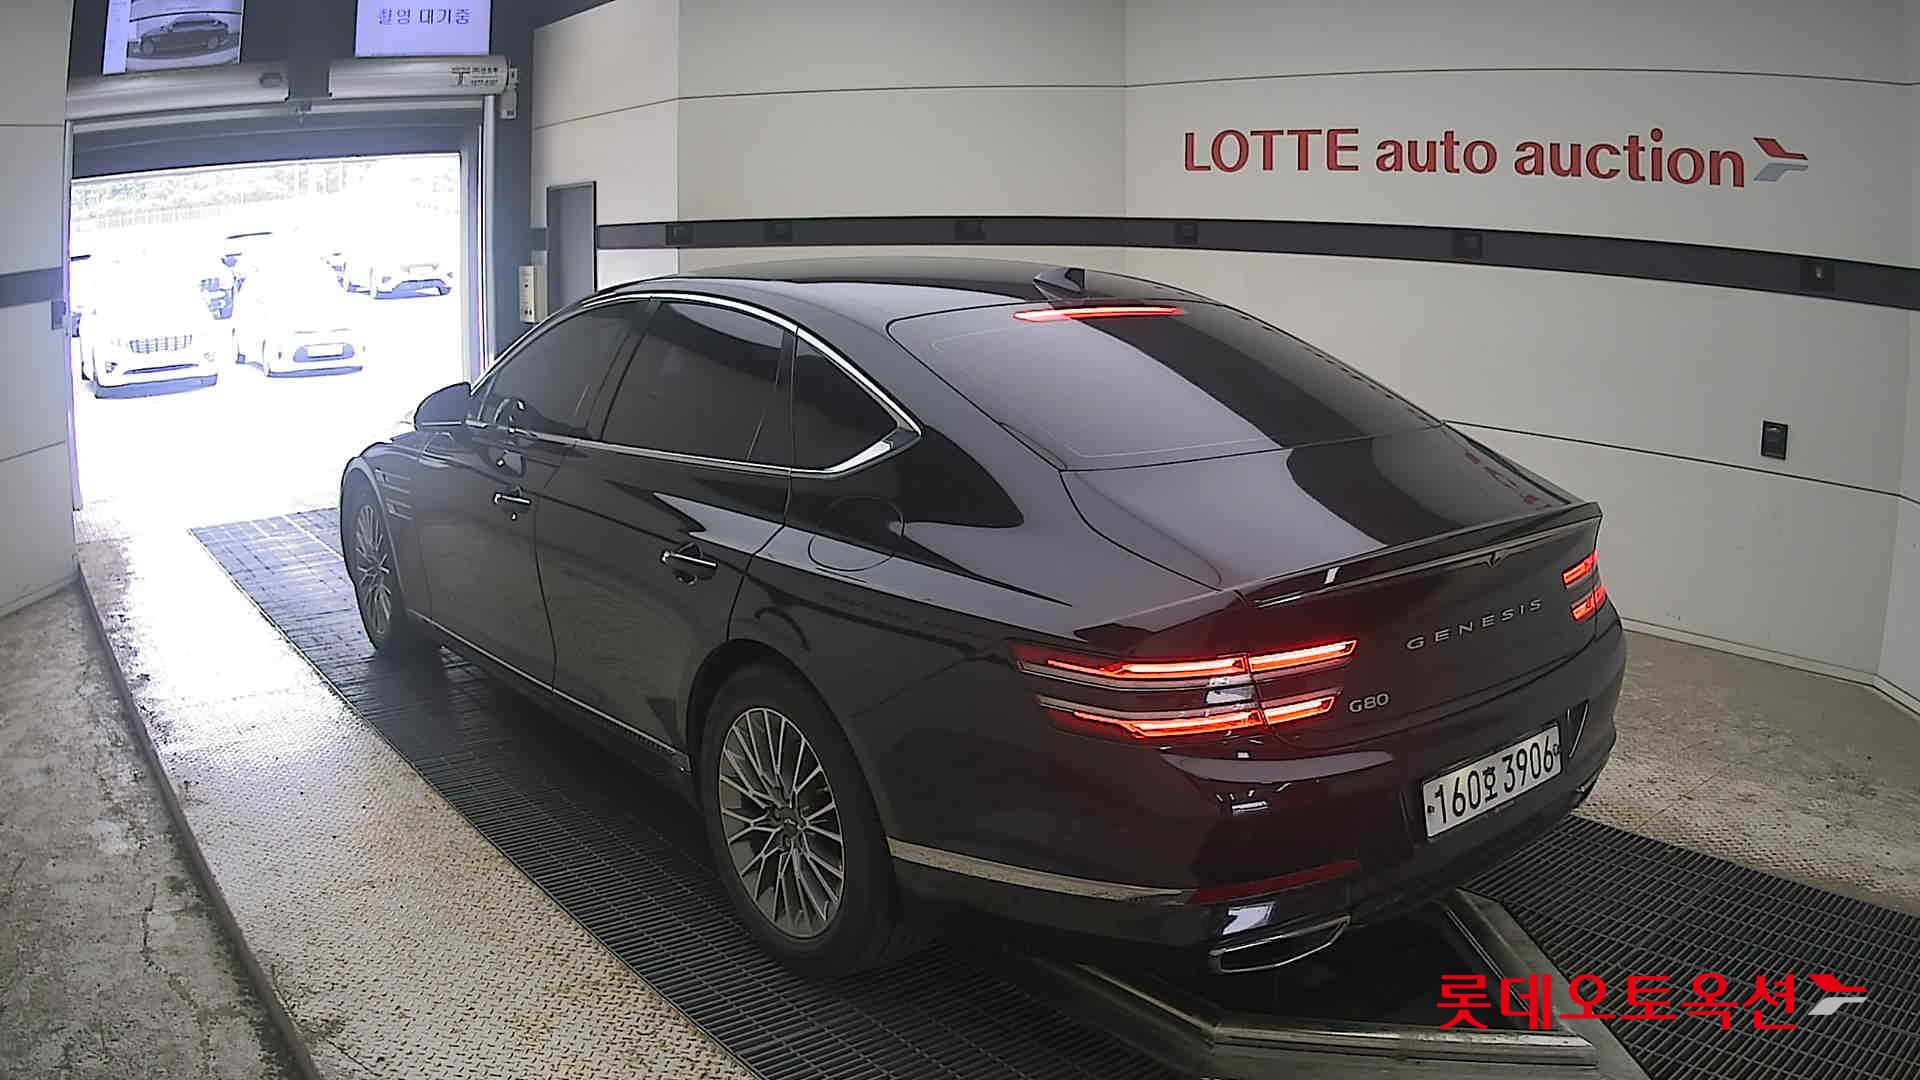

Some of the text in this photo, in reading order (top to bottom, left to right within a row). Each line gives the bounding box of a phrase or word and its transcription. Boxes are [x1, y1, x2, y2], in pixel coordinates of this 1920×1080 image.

[419, 8, 471, 24] 대기중
[1184, 128, 1746, 188] LOTTE auto auction
[1406, 598, 1543, 650] GENESIS
[1349, 692, 1390, 713] G80
